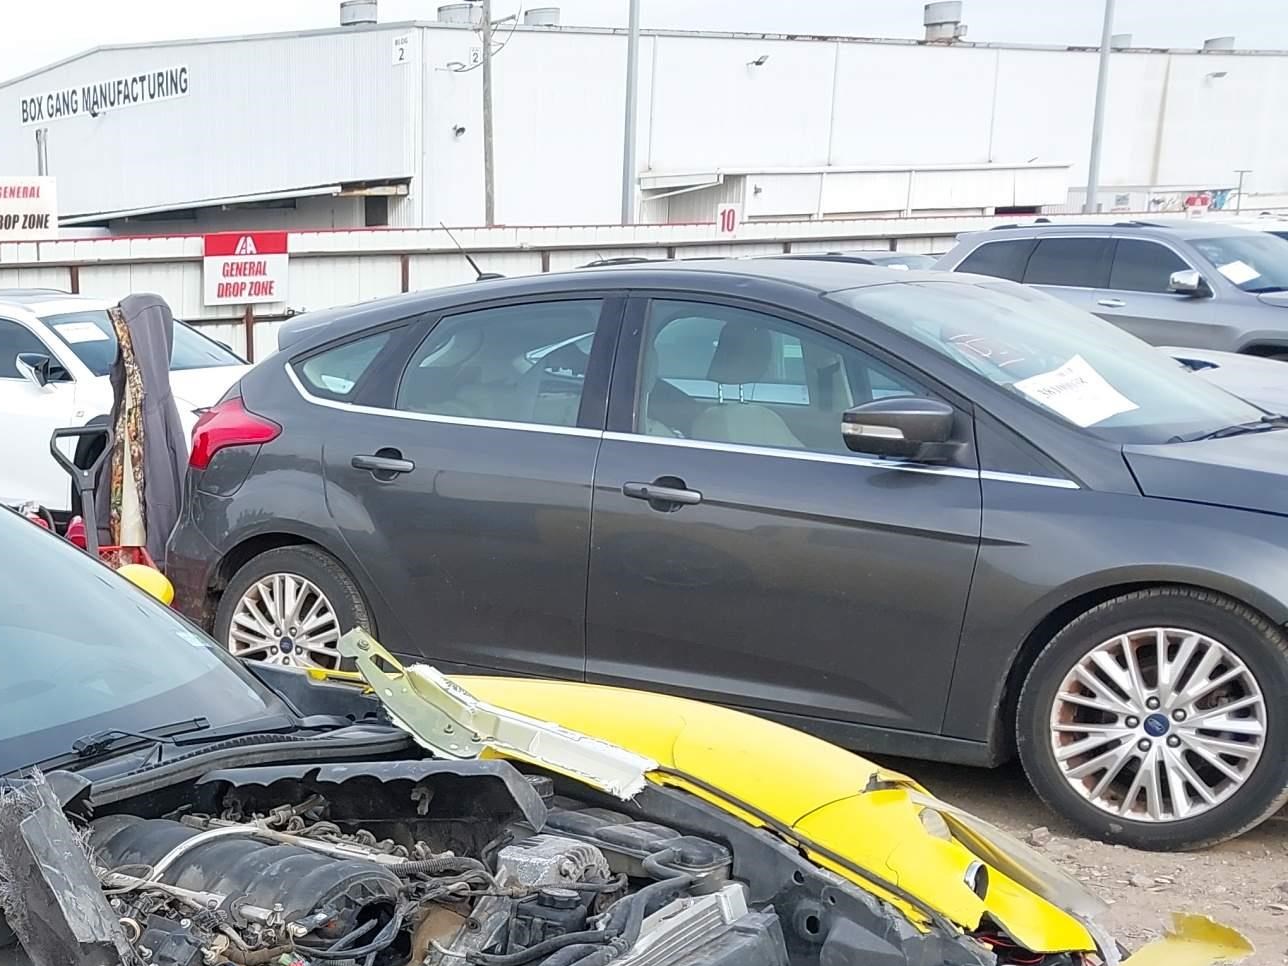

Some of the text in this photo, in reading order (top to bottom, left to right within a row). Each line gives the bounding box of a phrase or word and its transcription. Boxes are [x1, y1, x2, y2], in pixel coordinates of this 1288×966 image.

[398, 47, 405, 61] 2
[472, 52, 479, 63] 2
[22, 66, 188, 123] BOX GANG MANUFACTURING
[21, 213, 50, 230] ZONE
[720, 208, 735, 232] 10
[222, 260, 267, 277] GENERAL
[217, 280, 275, 298] DROP ZONE
